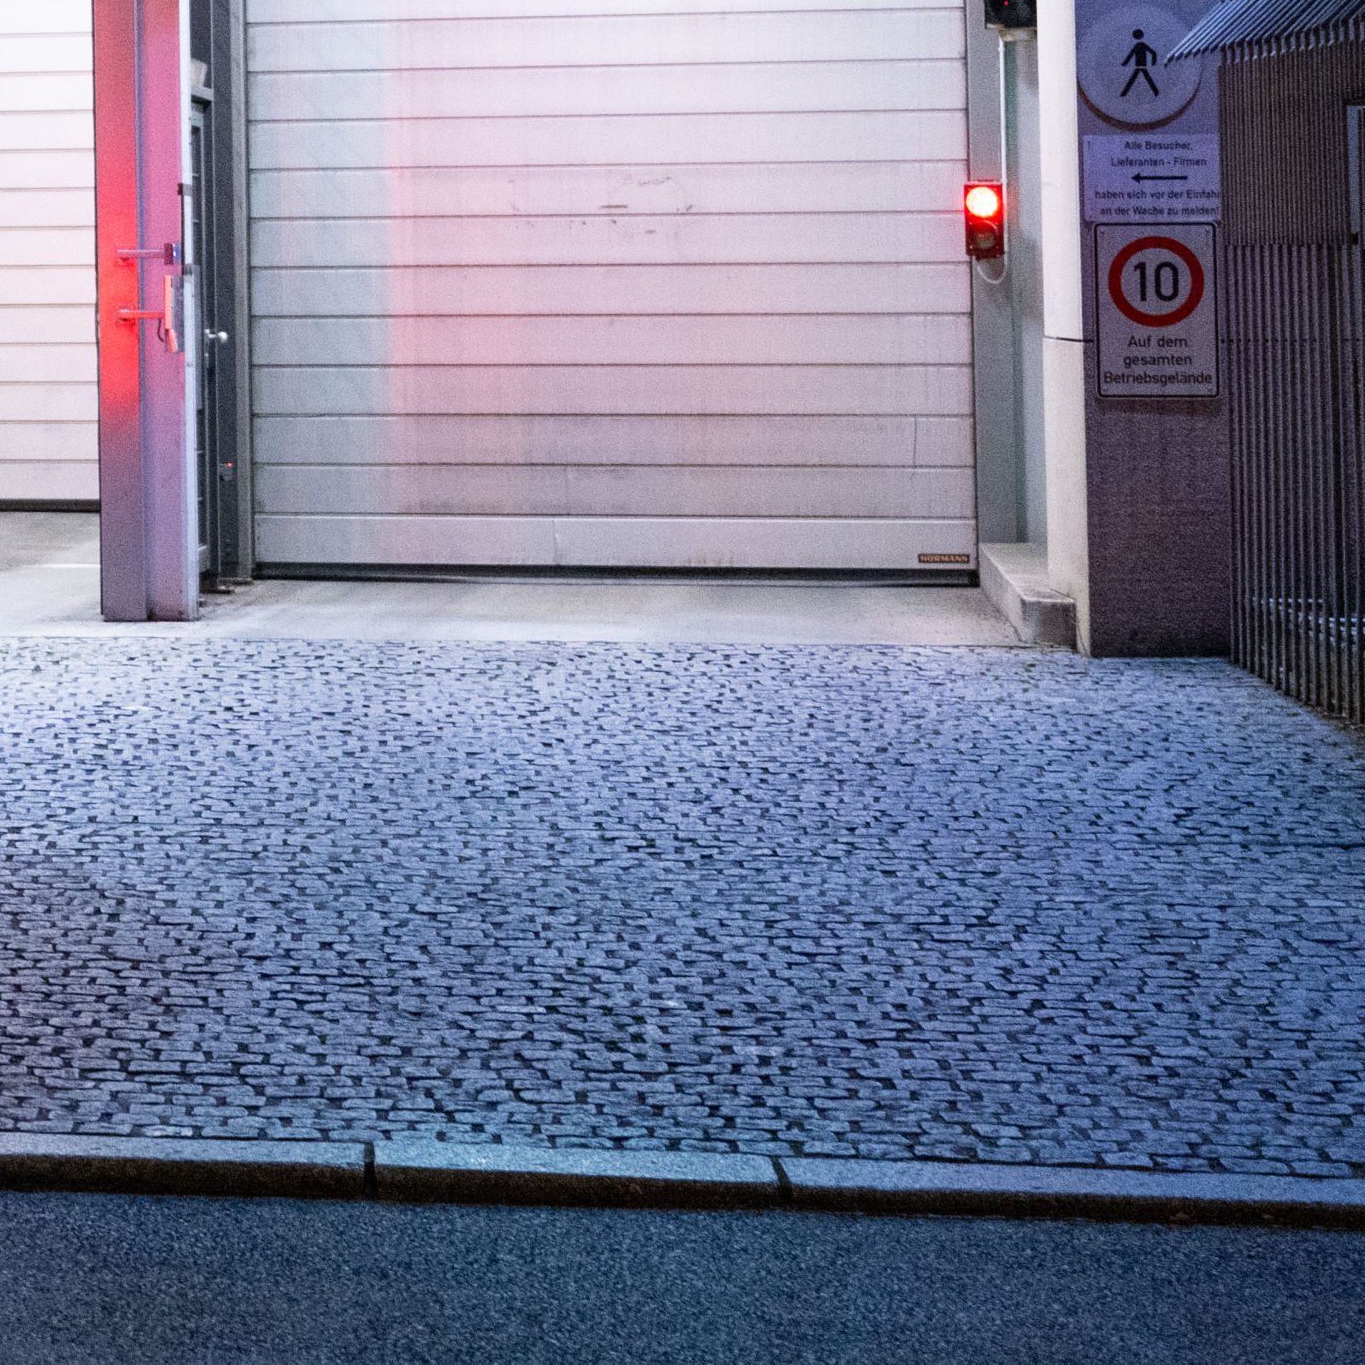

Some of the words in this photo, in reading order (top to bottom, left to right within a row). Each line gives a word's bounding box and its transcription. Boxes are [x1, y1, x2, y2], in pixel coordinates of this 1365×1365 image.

[1124, 140, 1143, 151] Alle
[1111, 156, 1164, 167] Lieferanten
[1173, 156, 1208, 167] Firmen
[1094, 189, 1124, 200] haben
[1127, 189, 1147, 200] sich
[1150, 191, 1165, 199] vor
[1168, 189, 1184, 199] der
[1100, 207, 1112, 215] an
[1114, 205, 1130, 215] der
[1133, 205, 1165, 216] Wache
[1167, 206, 1179, 215] zu
[1133, 261, 1179, 302] 10
[1127, 334, 1152, 347] Auf
[1156, 335, 1188, 348] dem
[1123, 354, 1192, 368] gesamten
[1103, 371, 1213, 386] Betriebsgelände
